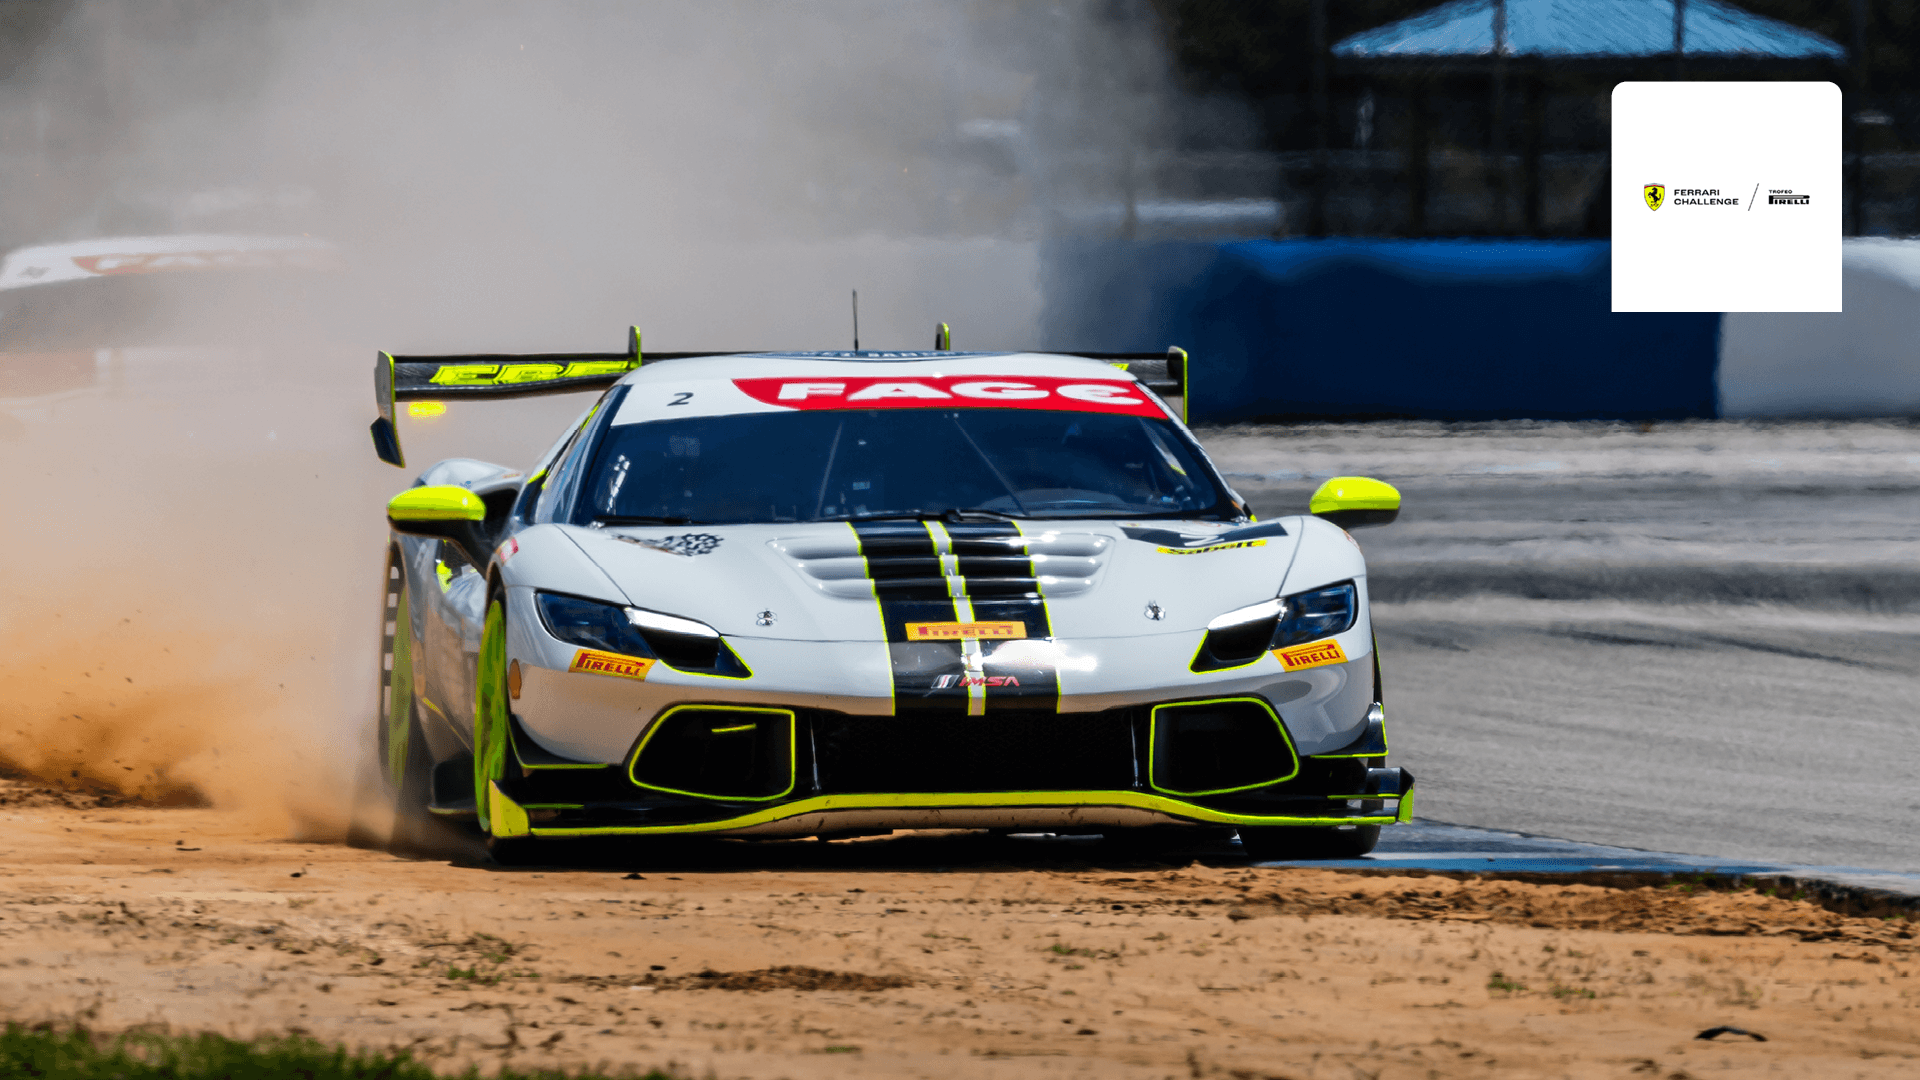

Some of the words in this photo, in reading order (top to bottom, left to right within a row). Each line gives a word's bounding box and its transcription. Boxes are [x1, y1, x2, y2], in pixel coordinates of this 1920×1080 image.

[666, 392, 695, 407] 2
[777, 382, 1144, 405] FAGE
[575, 652, 646, 677] PIRELLI
[1280, 643, 1341, 667] PIRELLI
[958, 676, 1020, 687] IMSA
